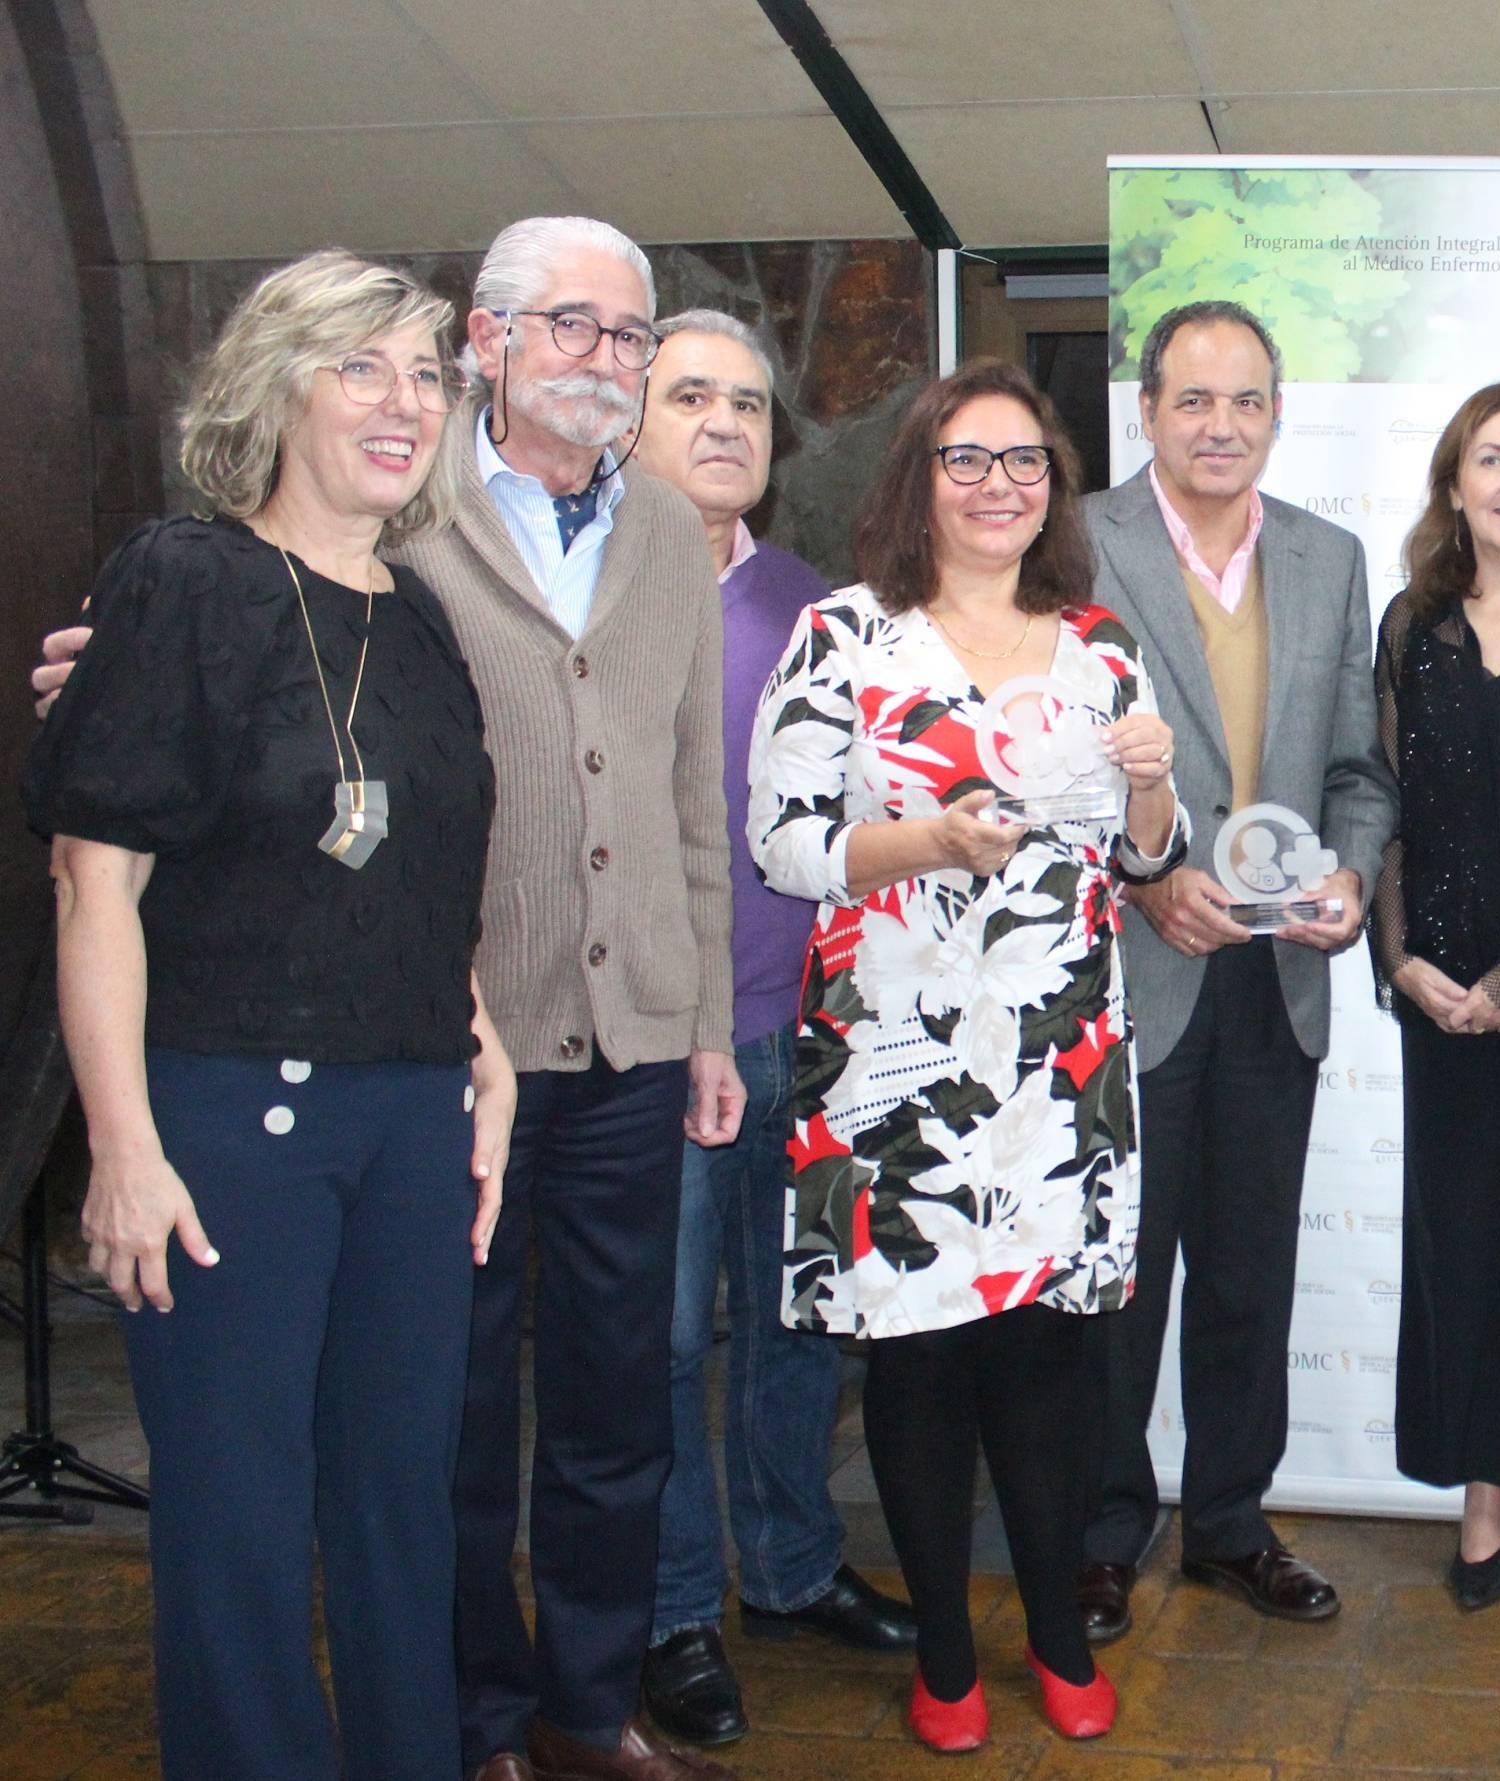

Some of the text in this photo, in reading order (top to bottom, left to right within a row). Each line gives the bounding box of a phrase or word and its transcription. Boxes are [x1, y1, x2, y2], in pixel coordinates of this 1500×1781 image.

[1243, 233, 1500, 255] Programa de Atención Integral
[1343, 255, 1357, 271] al
[1363, 254, 1424, 272] Médico
[1305, 497, 1353, 515] OMC
